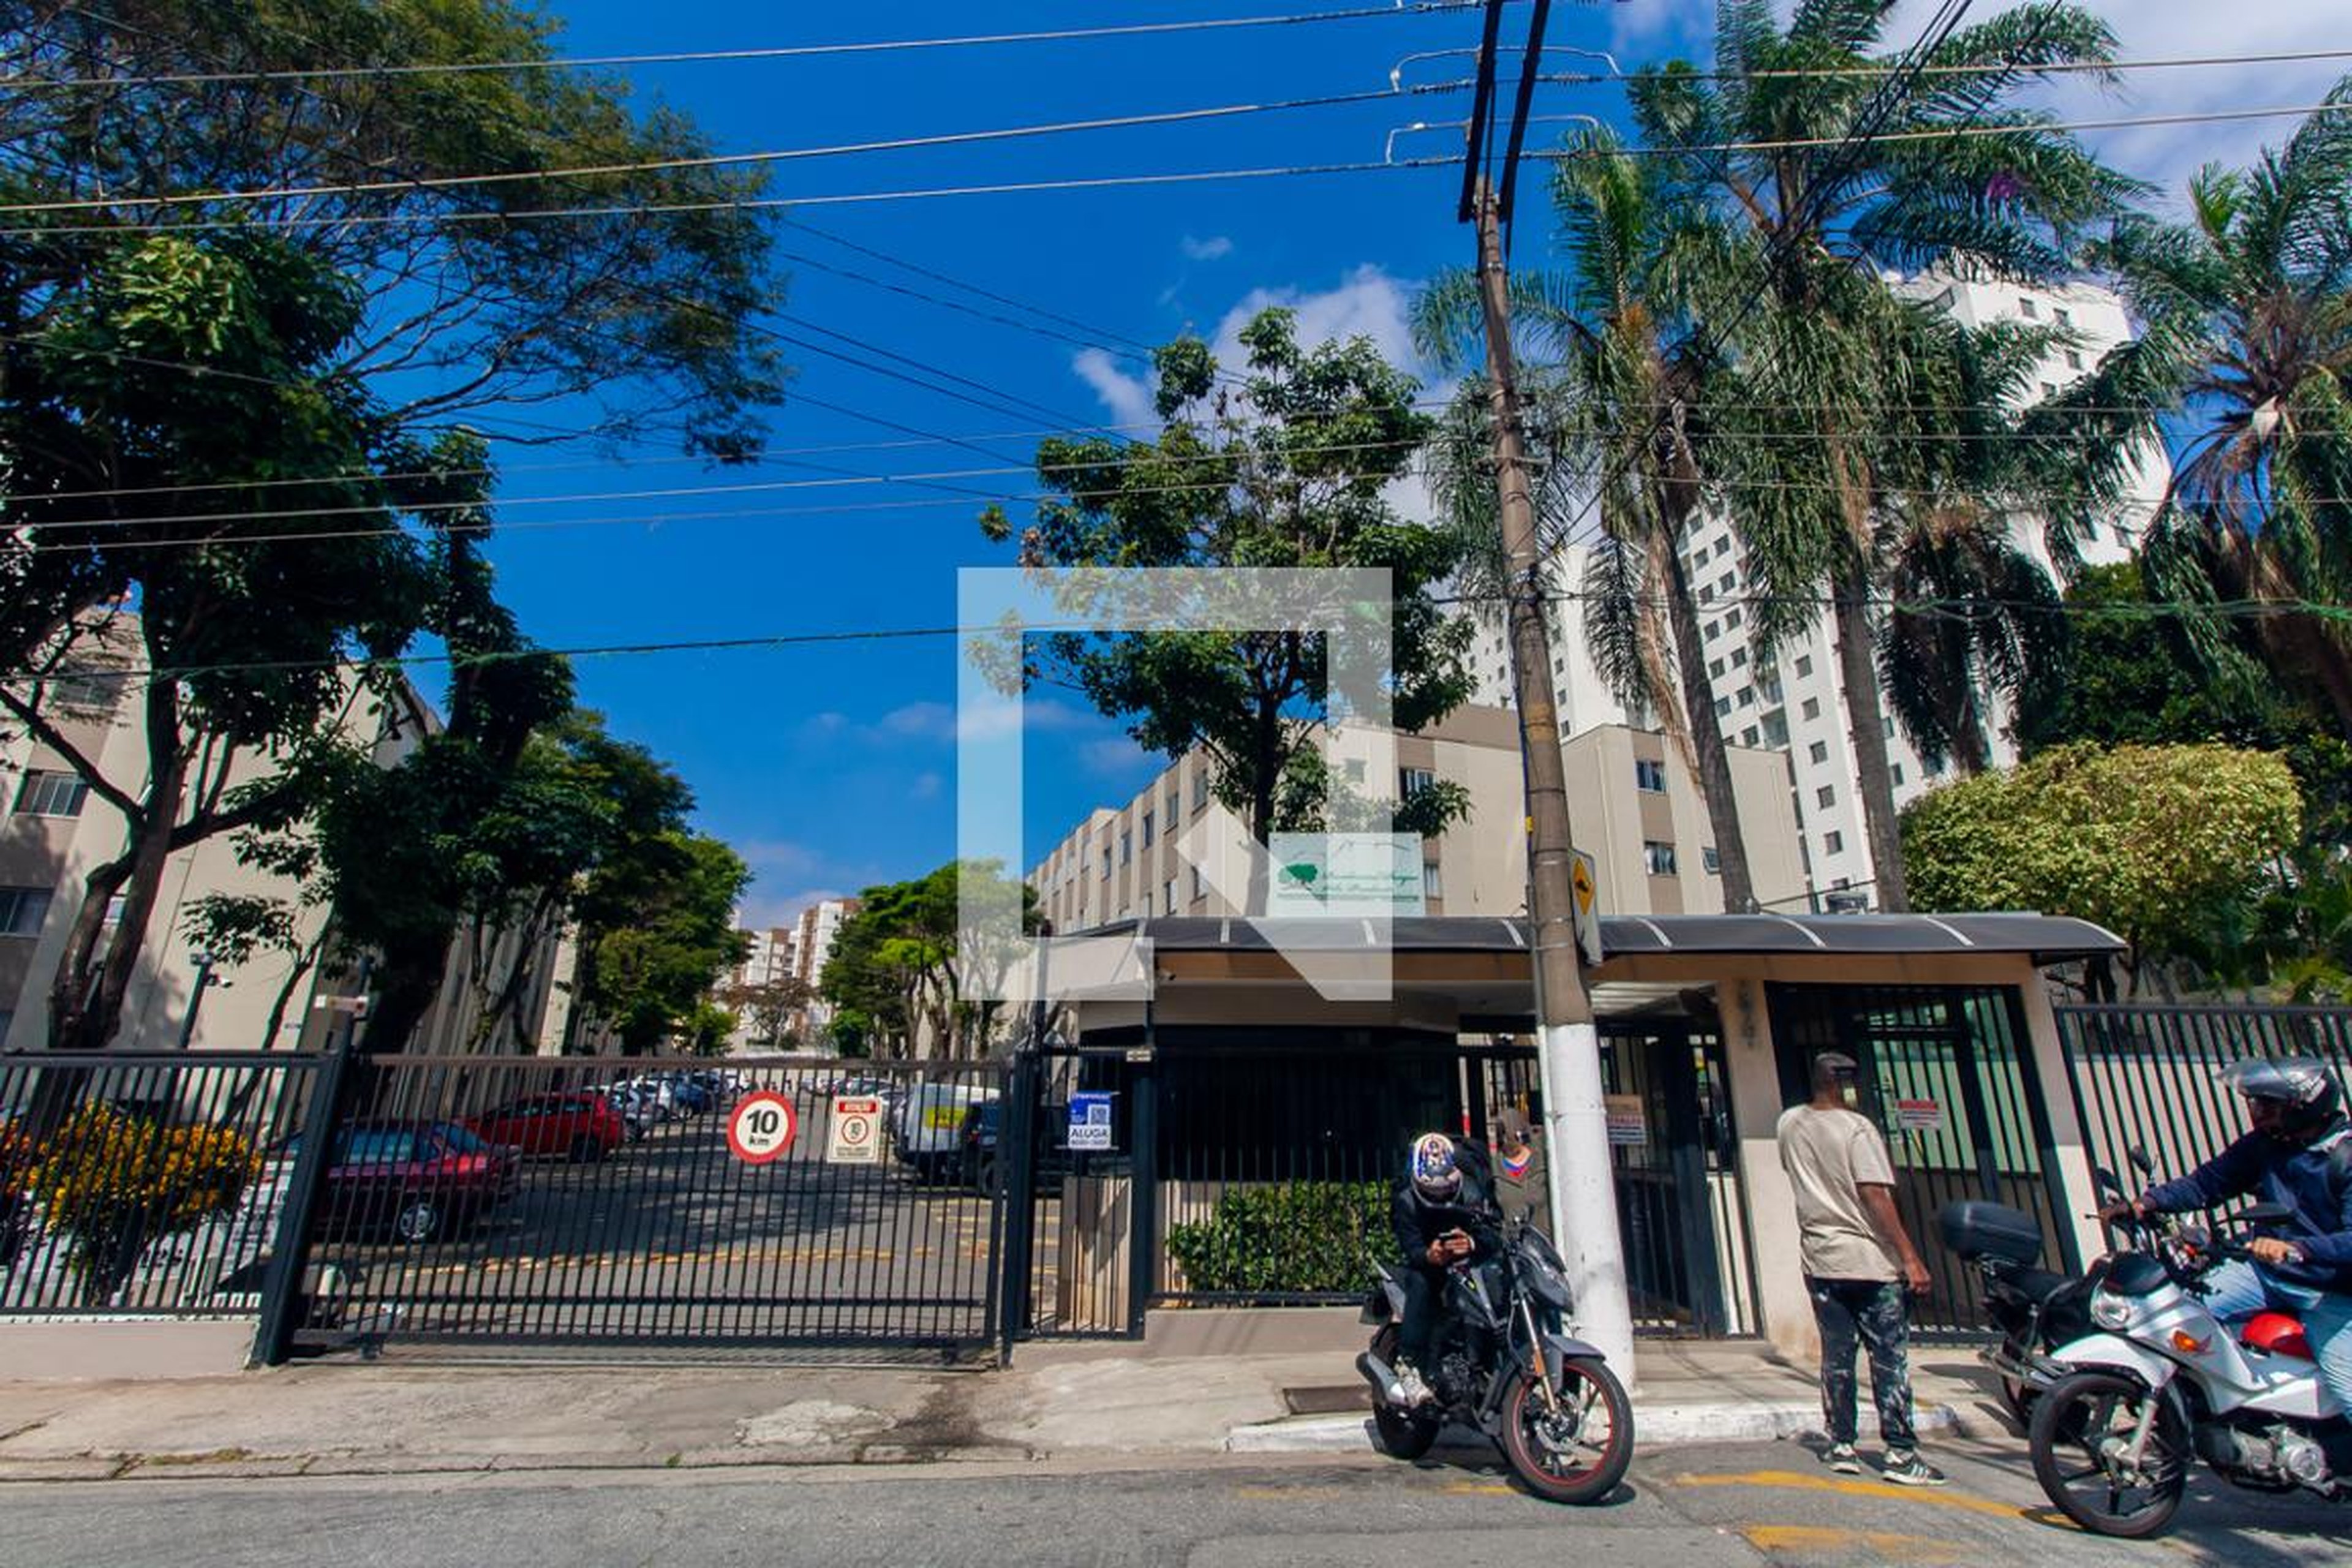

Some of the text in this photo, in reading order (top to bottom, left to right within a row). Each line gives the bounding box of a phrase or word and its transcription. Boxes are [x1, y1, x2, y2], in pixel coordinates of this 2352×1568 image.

[747, 1109, 778, 1134] 10
[1071, 1128, 1109, 1137] ALUGA
[749, 1135, 770, 1145] km
